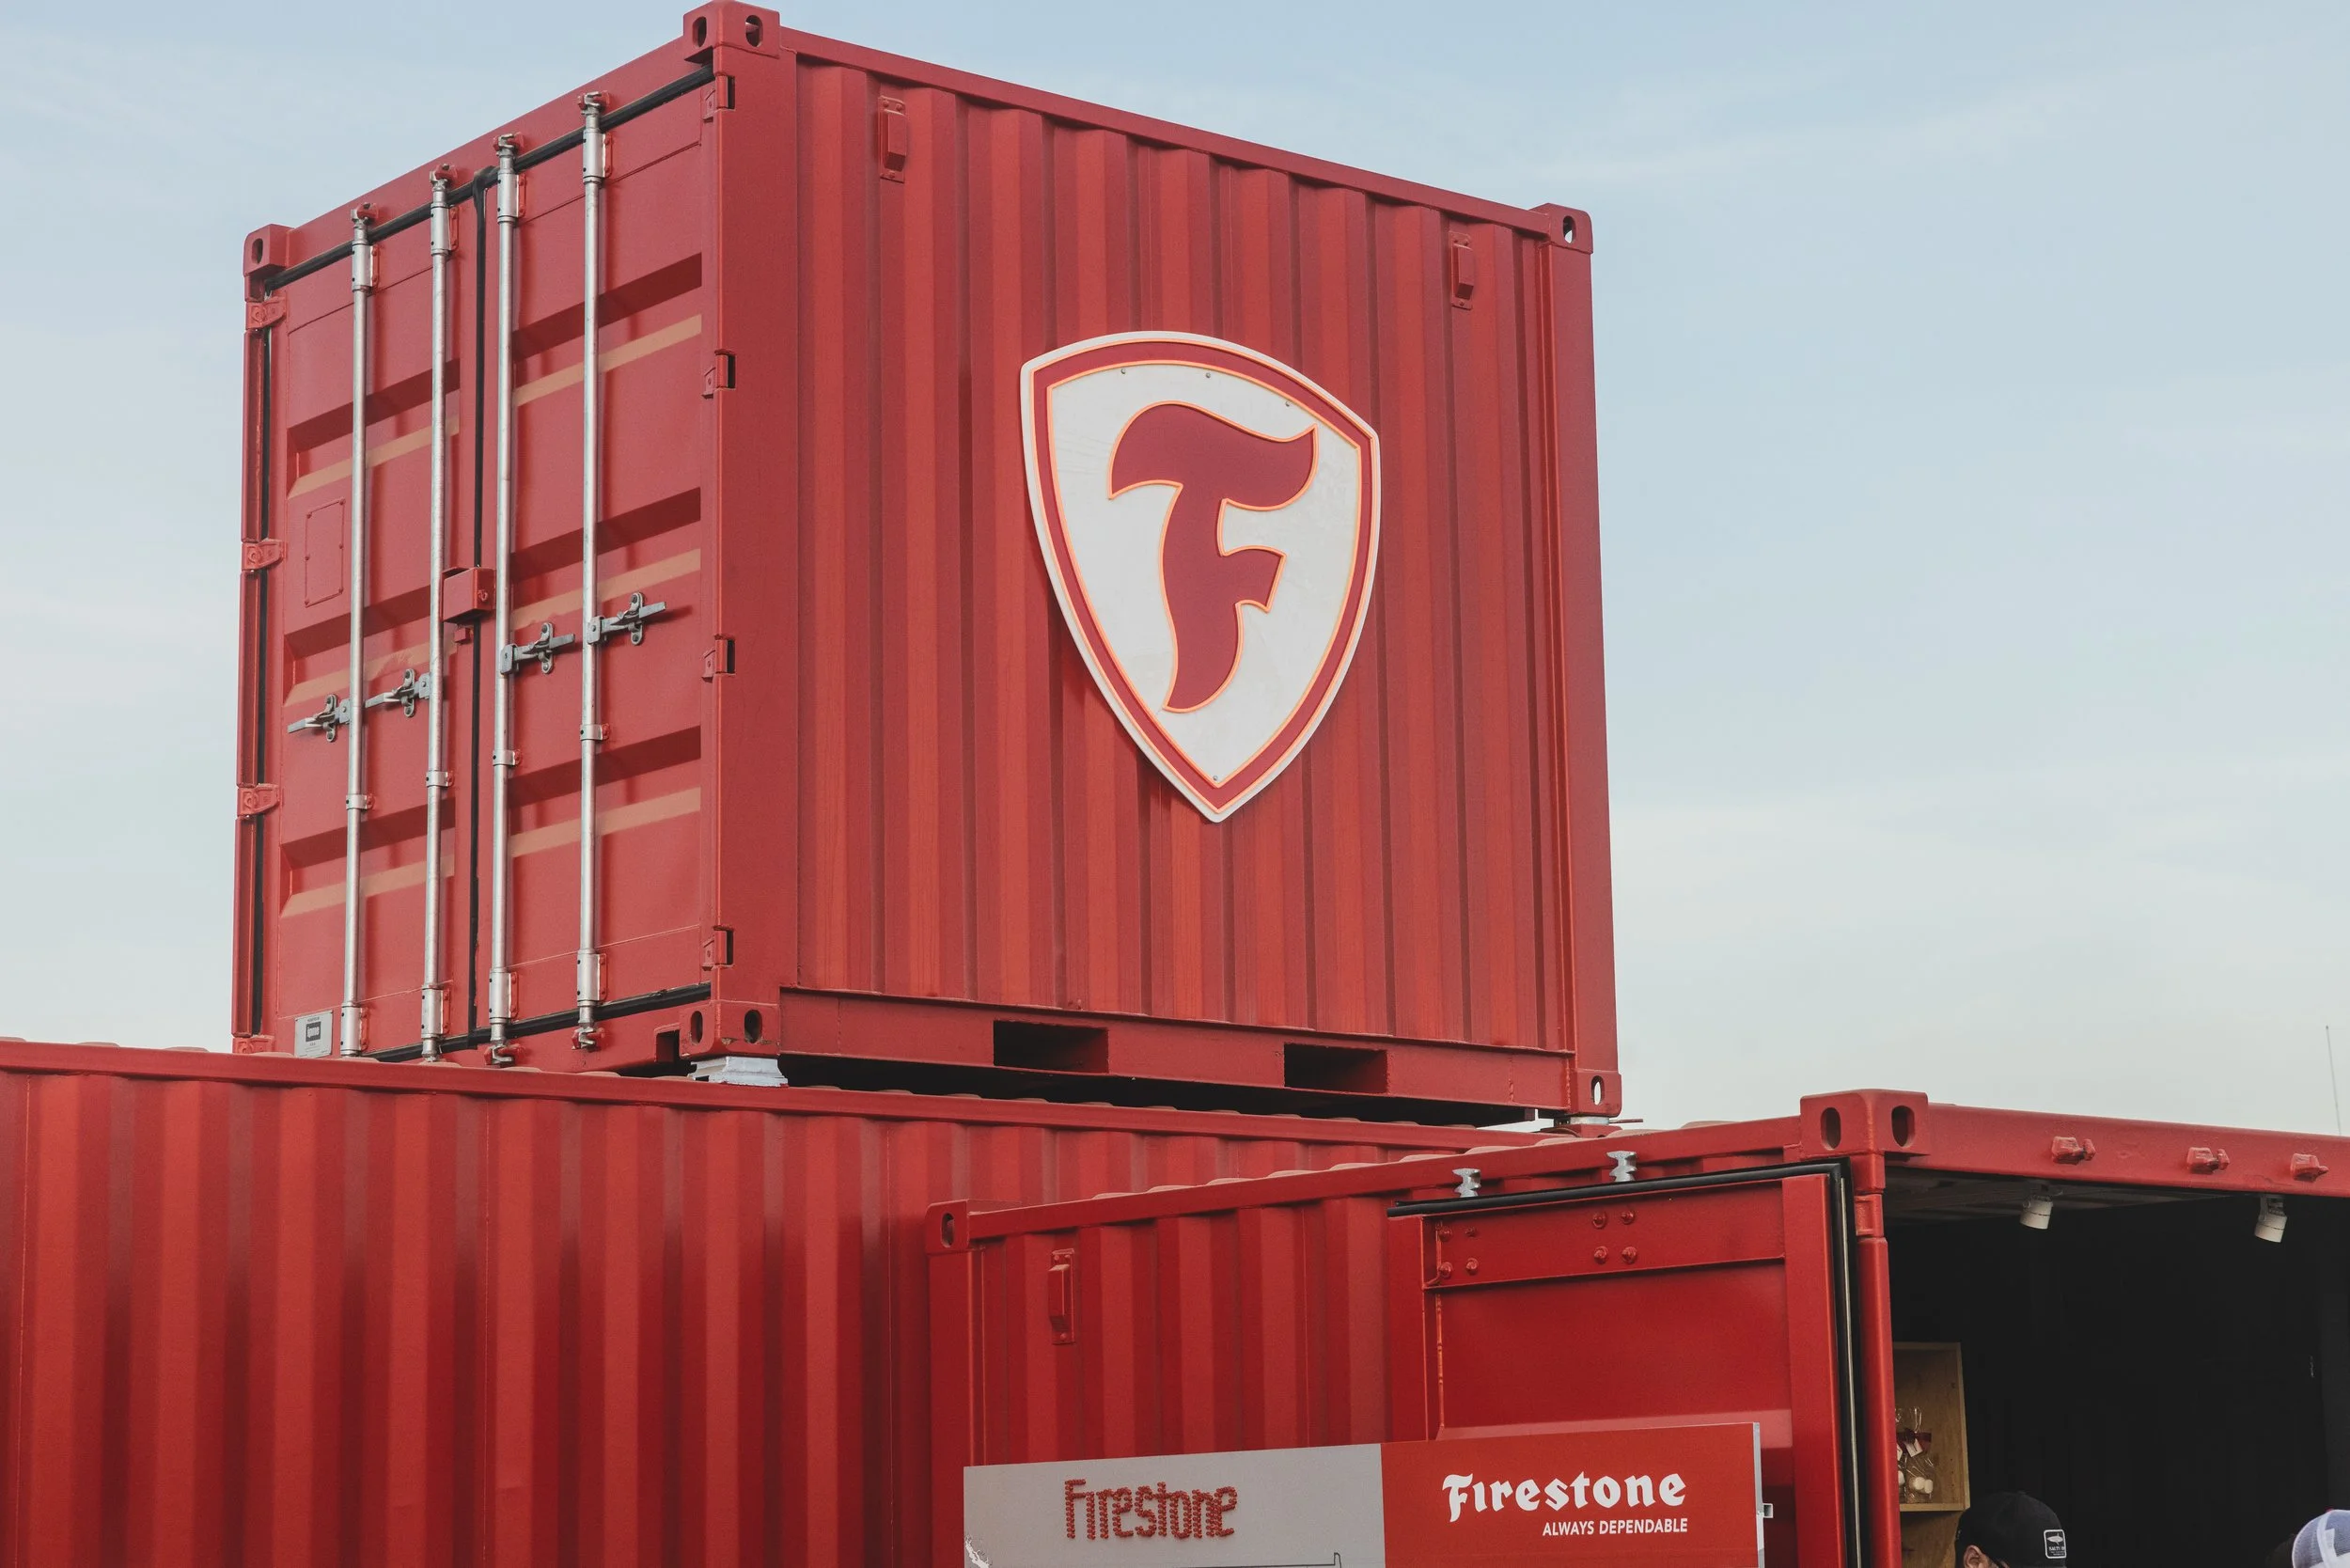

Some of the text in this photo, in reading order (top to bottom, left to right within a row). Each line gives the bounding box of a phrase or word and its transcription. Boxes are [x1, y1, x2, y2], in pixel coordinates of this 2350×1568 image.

[1109, 401, 1318, 713] F
[1065, 1479, 1237, 1539] Firestone
[1442, 1471, 1686, 1523] Firestone
[1543, 1518, 1688, 1536] ALWAYS DEPENDABLE
